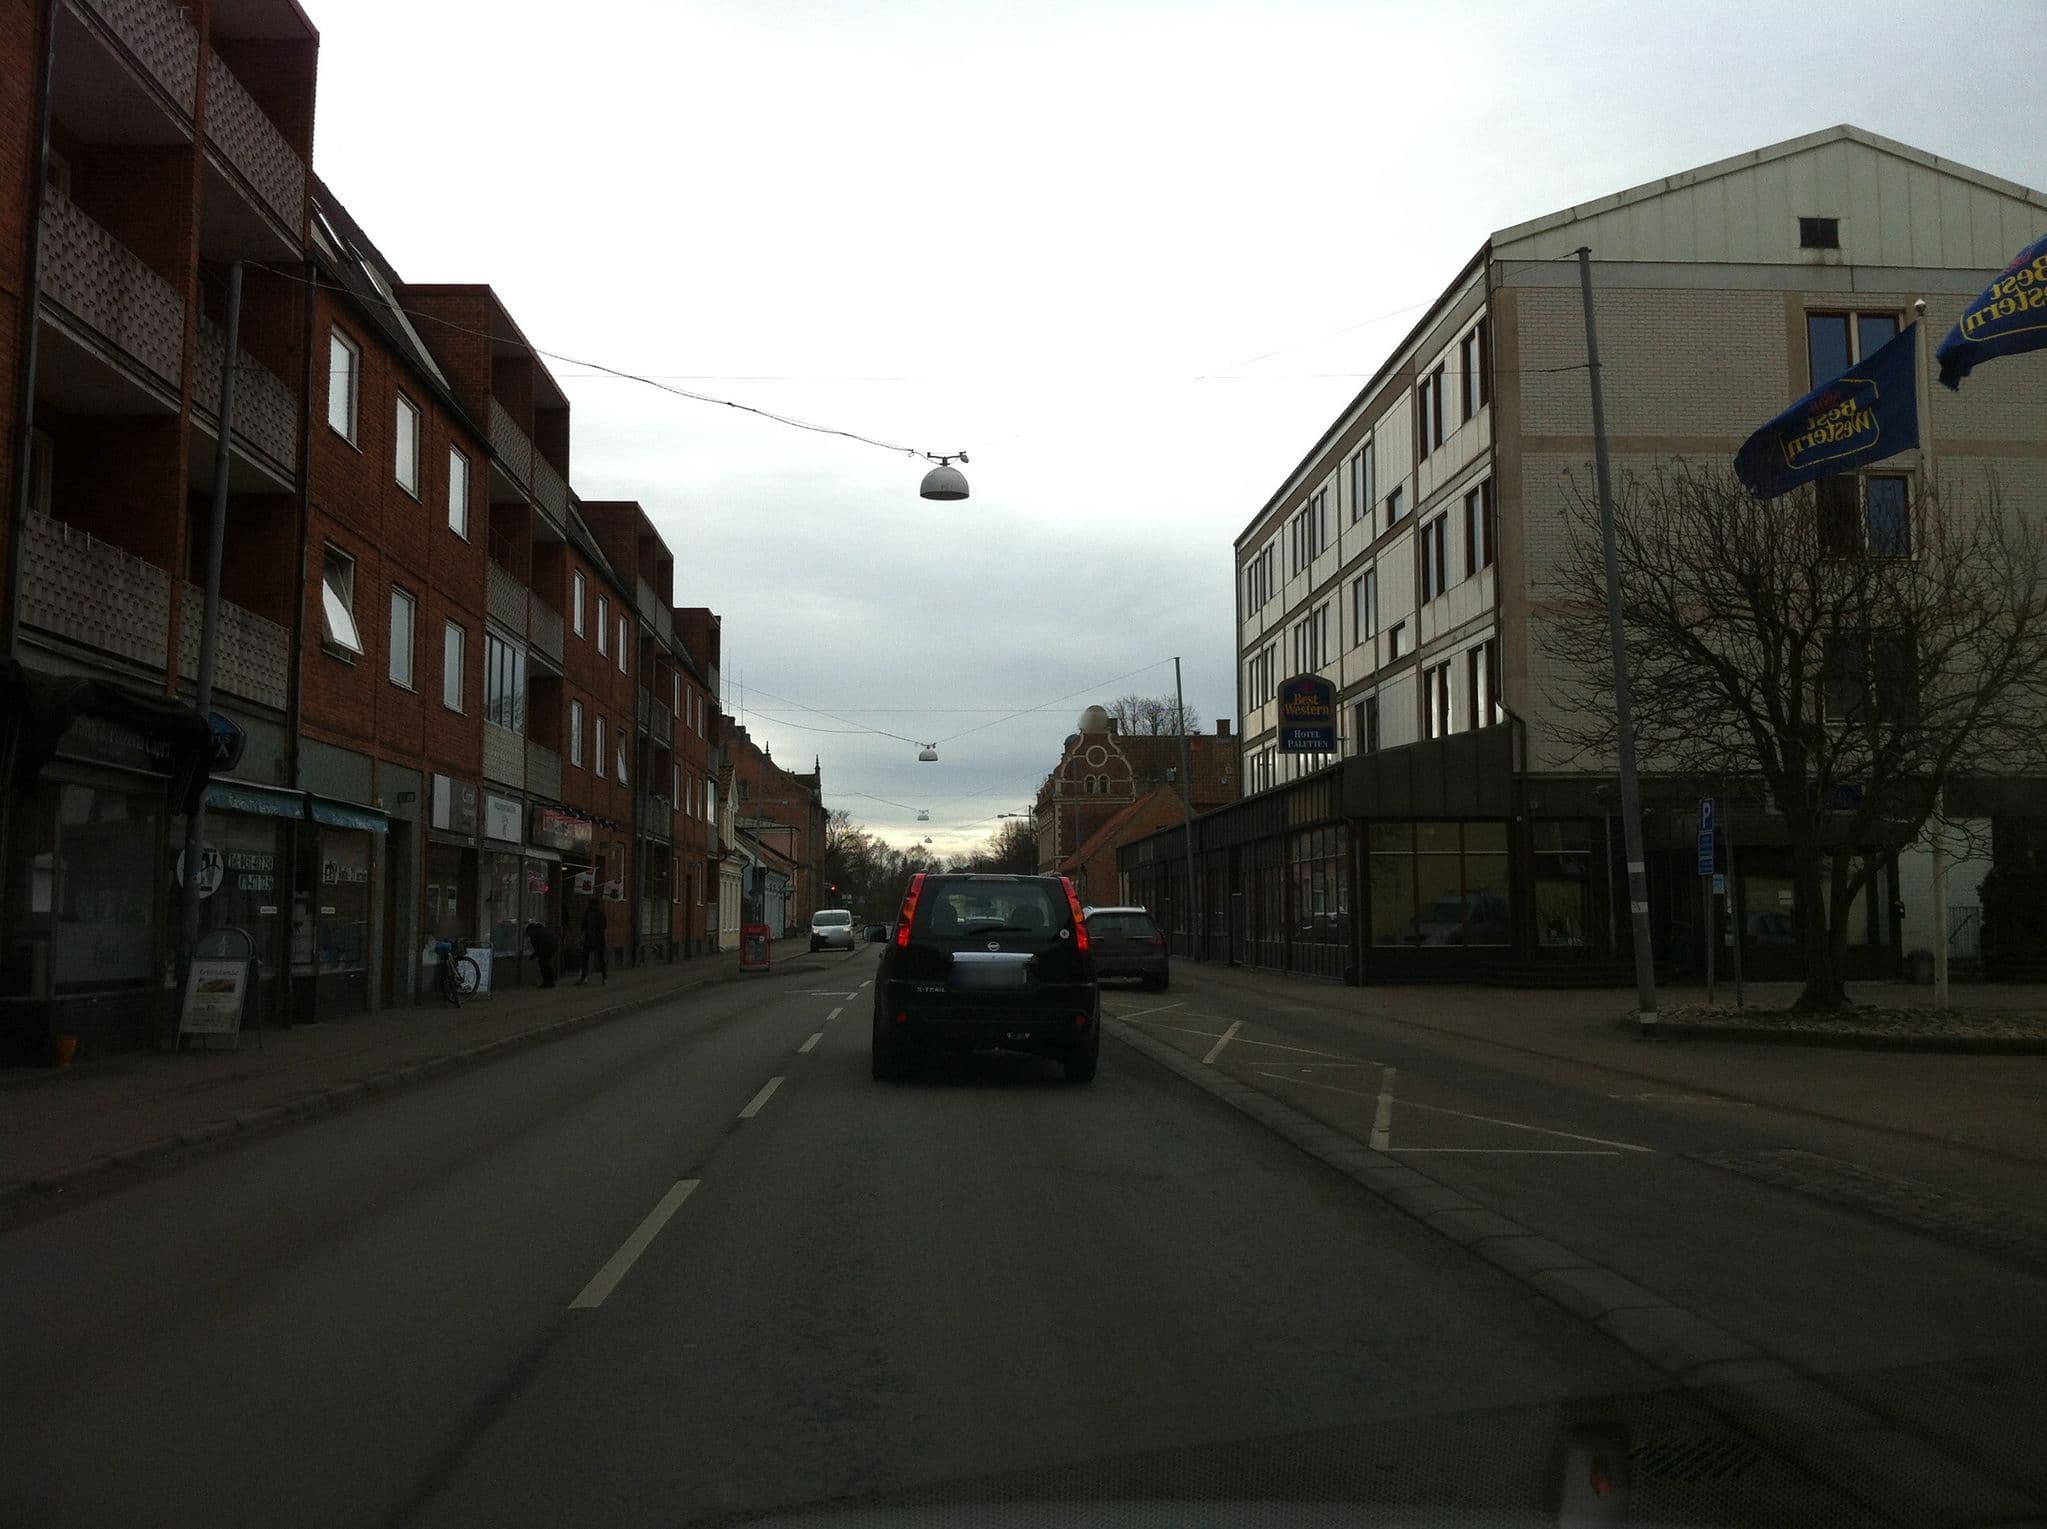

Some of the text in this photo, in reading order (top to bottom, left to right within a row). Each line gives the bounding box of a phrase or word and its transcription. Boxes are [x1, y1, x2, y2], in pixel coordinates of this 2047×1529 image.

[1295, 692, 1319, 705] Best
[1283, 703, 1329, 715] Western
[1294, 729, 1321, 739] HOTEL
[1702, 802, 1711, 829] P
